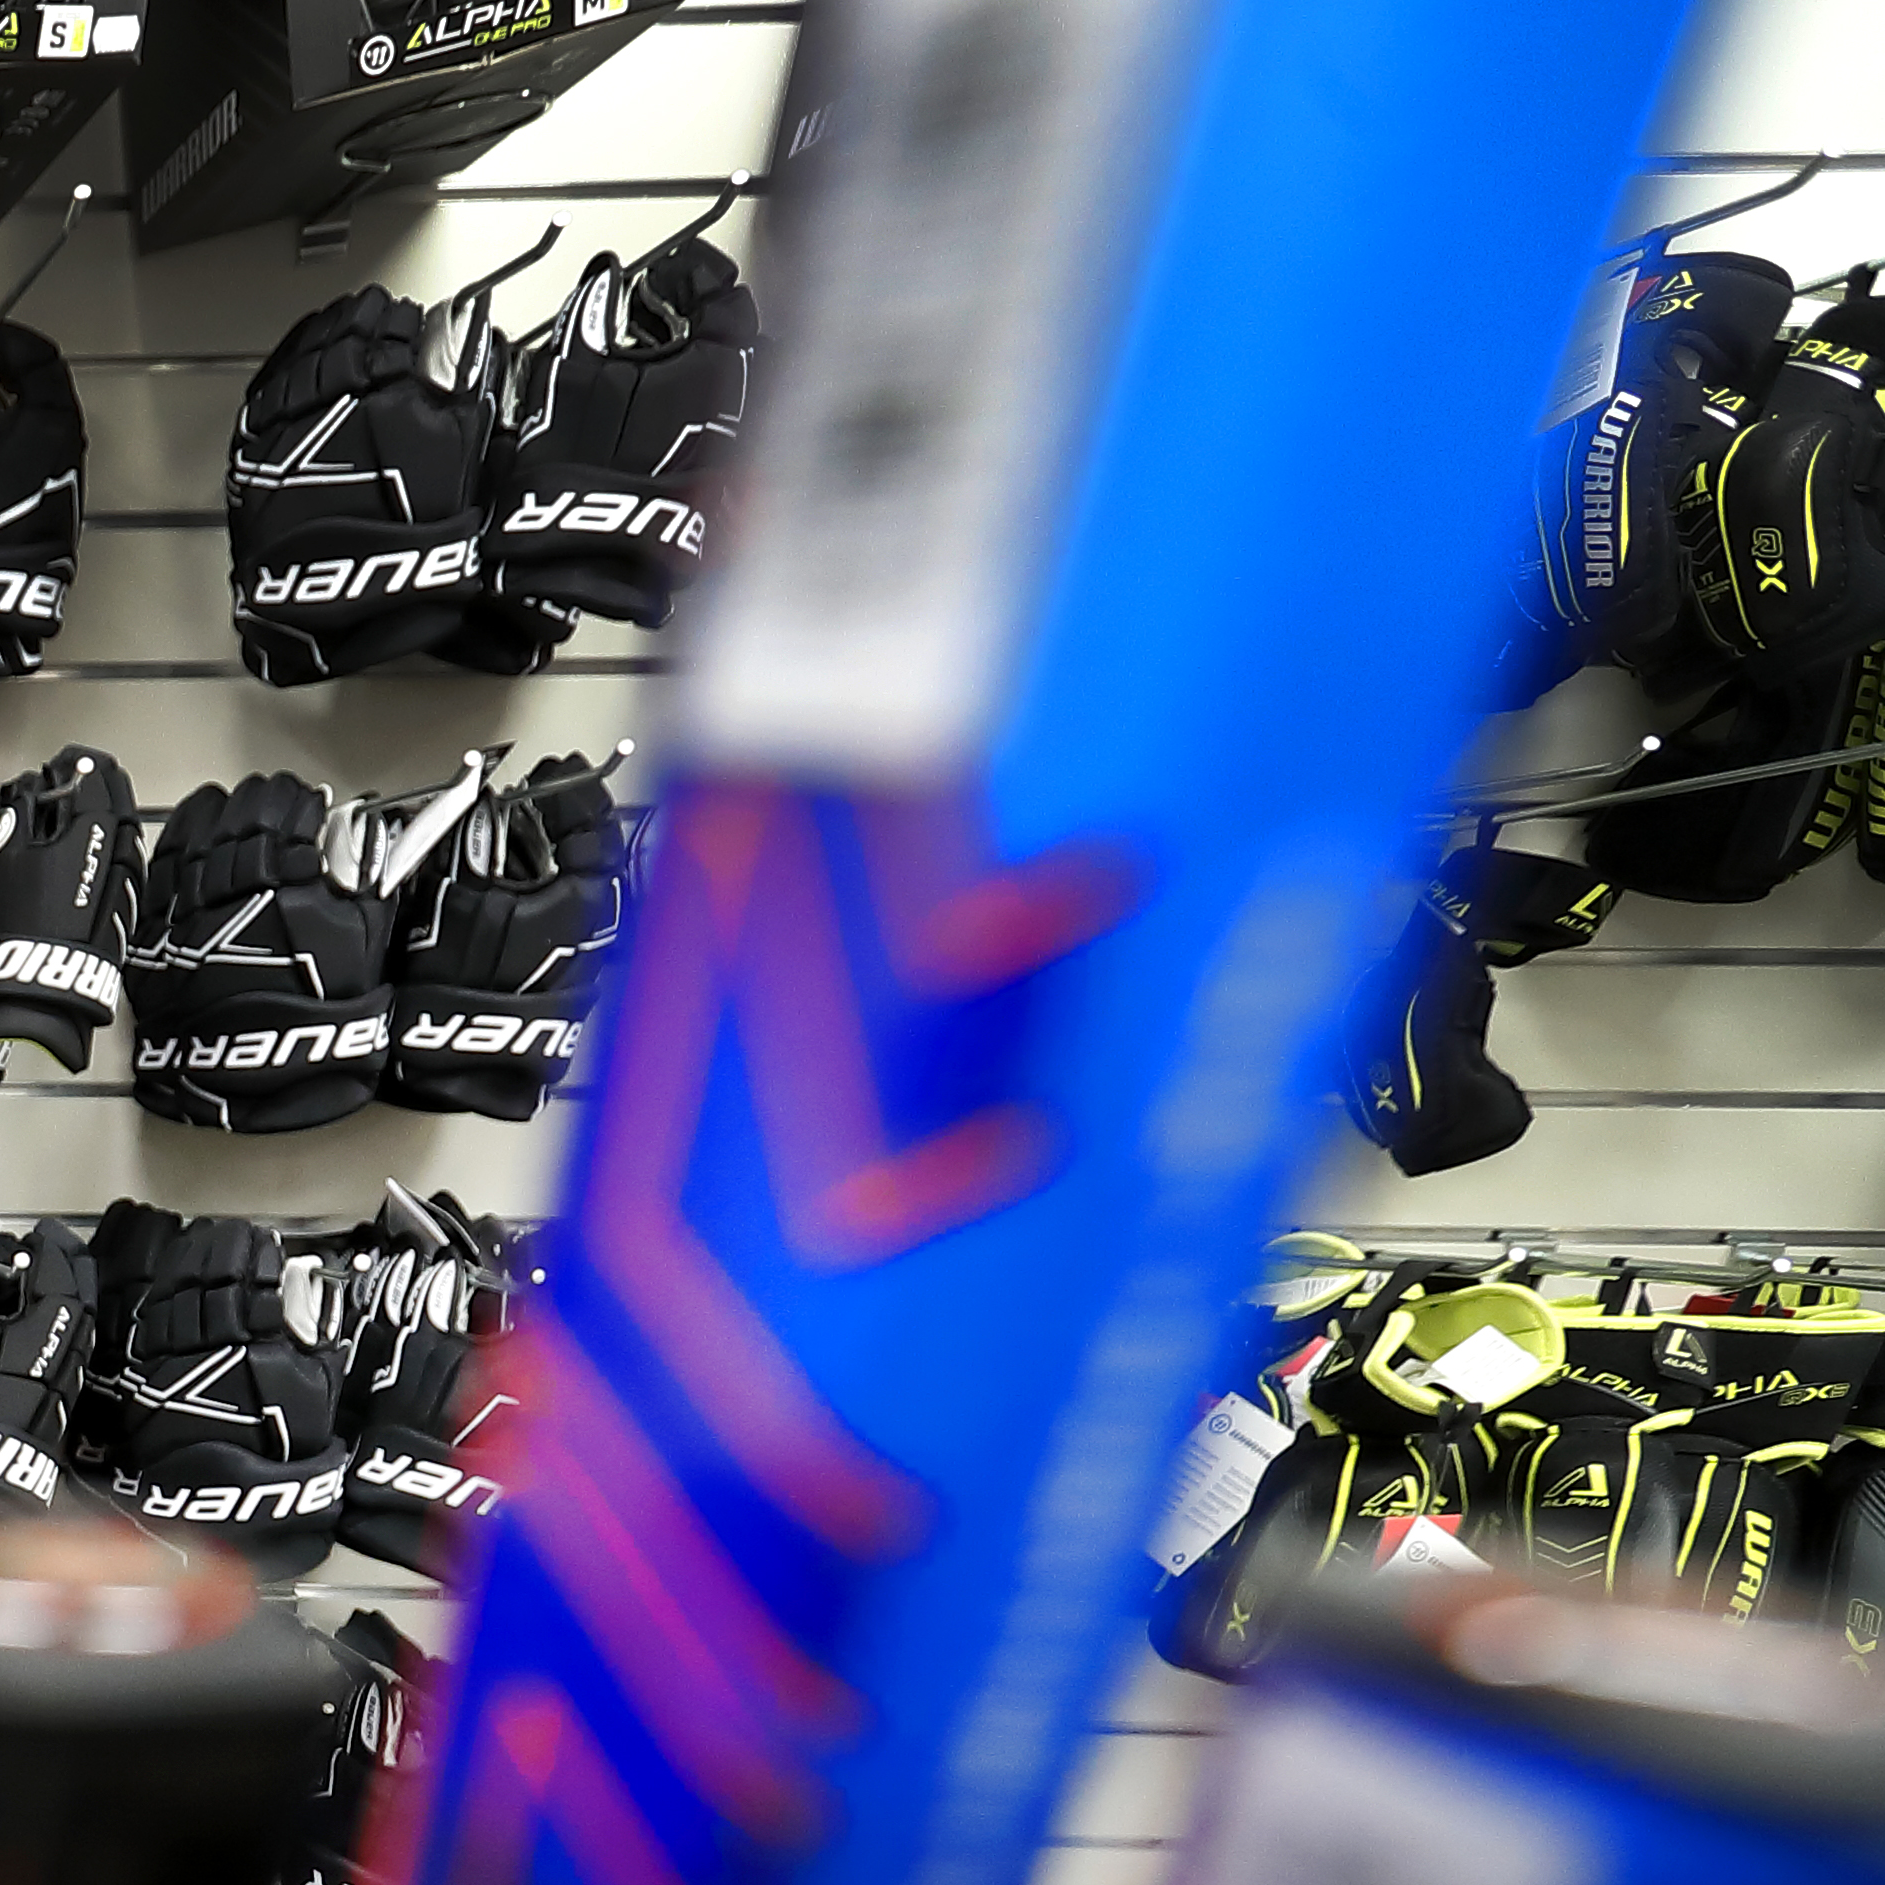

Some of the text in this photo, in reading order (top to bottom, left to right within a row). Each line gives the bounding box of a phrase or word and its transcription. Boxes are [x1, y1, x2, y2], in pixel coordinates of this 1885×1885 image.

[406, 0, 552, 50] ALPHA
[1583, 391, 1643, 589] WARRIOR
[503, 491, 706, 560] AUER
[74, 824, 105, 907] ALPHA
[402, 1012, 585, 1058] AUER
[30, 1305, 71, 1378] ALPHA
[356, 1447, 505, 1517] UER
